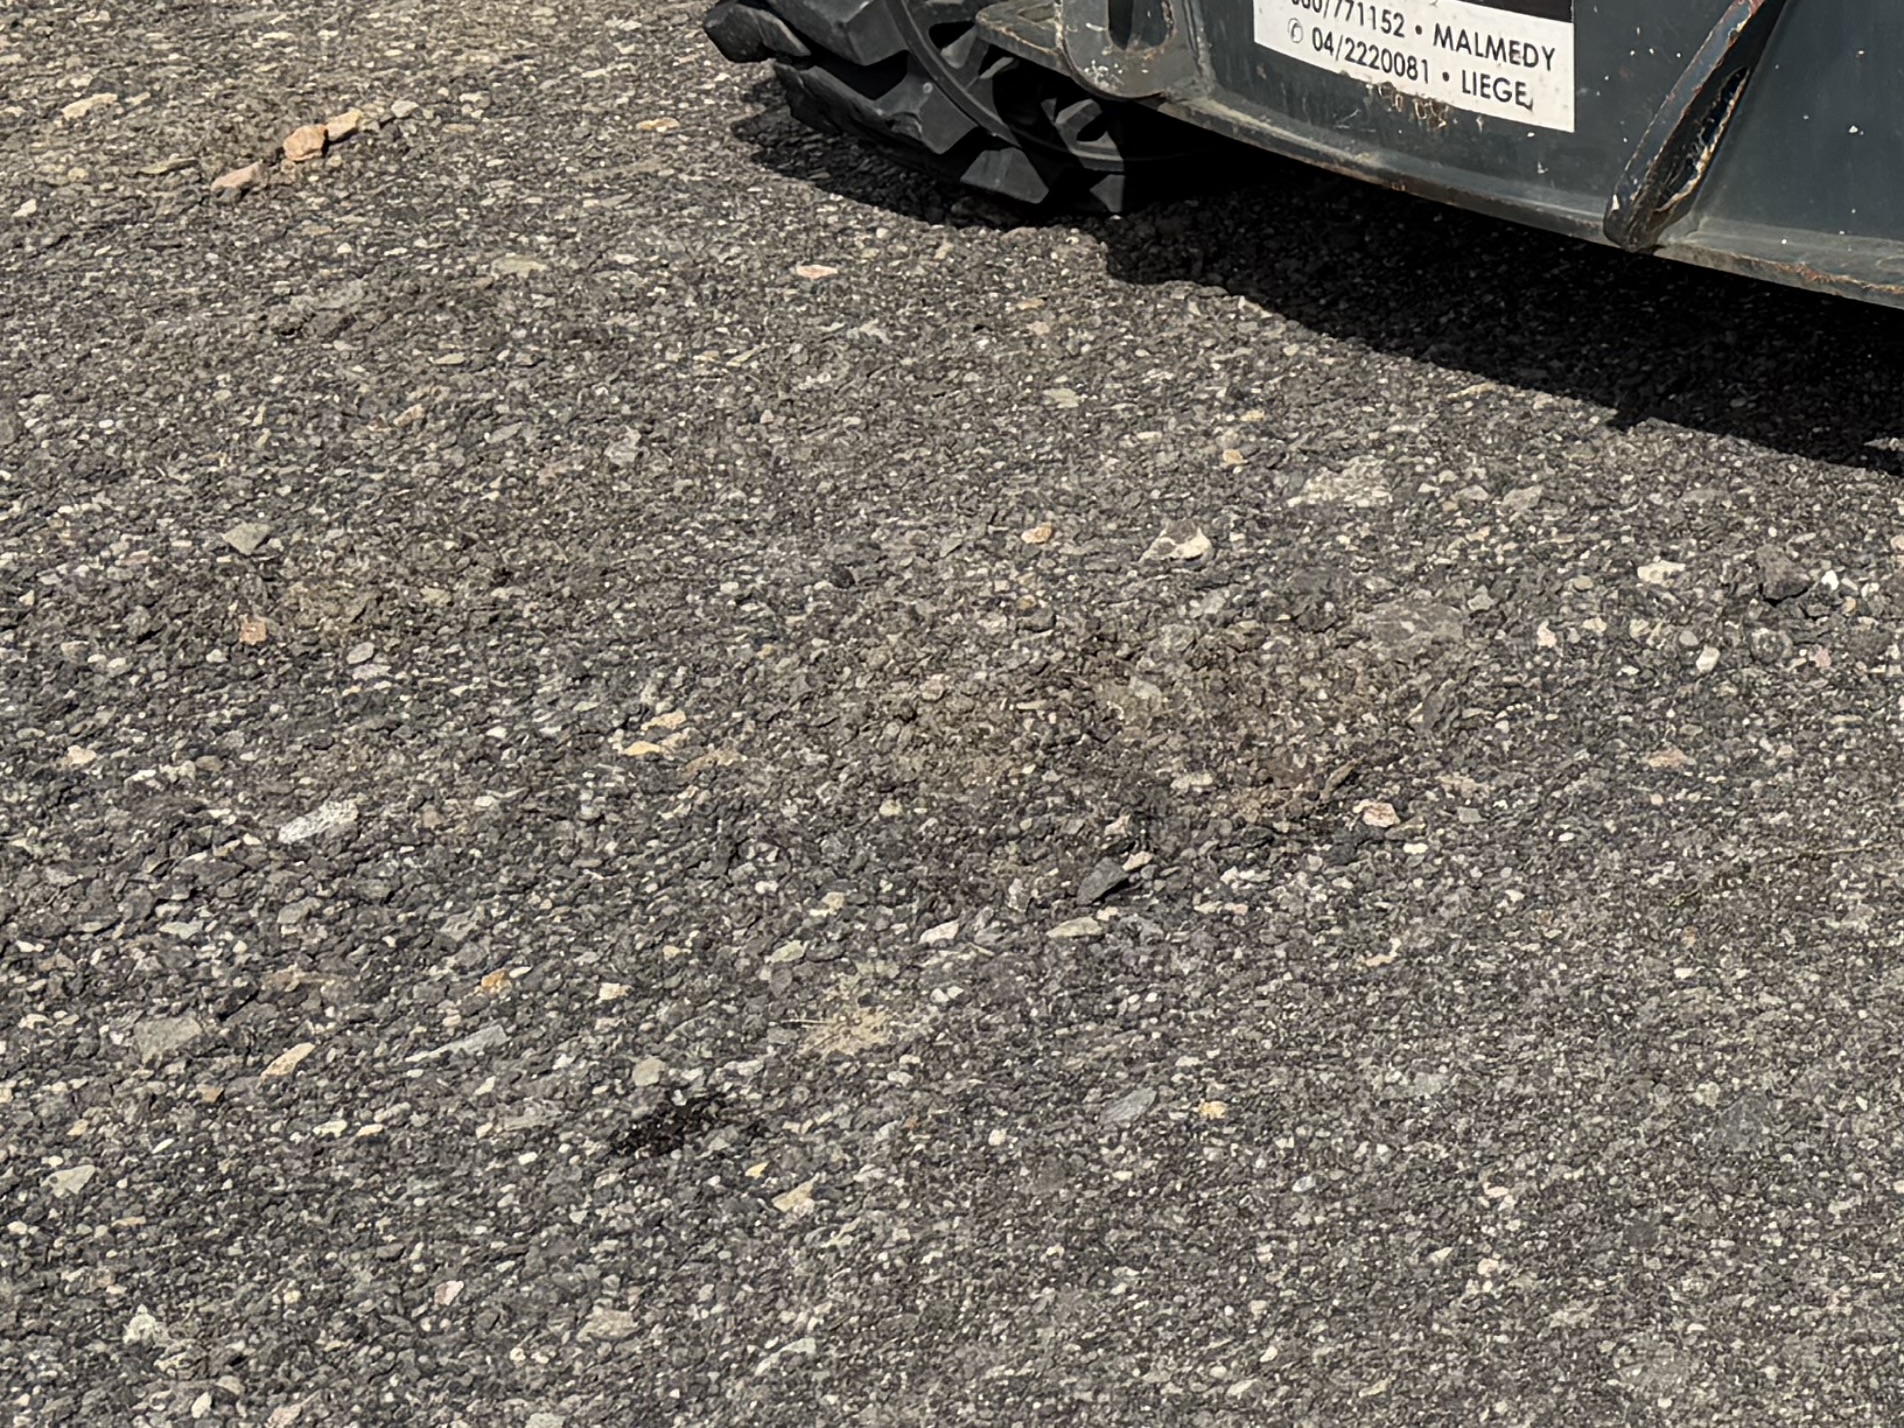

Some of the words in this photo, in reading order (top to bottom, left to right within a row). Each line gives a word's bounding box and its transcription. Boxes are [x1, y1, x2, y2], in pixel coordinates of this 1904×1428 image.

[1312, 26, 1429, 84] 04/2220081
[1461, 69, 1533, 110] LIEGE
[1433, 22, 1555, 72] MALMEDY
